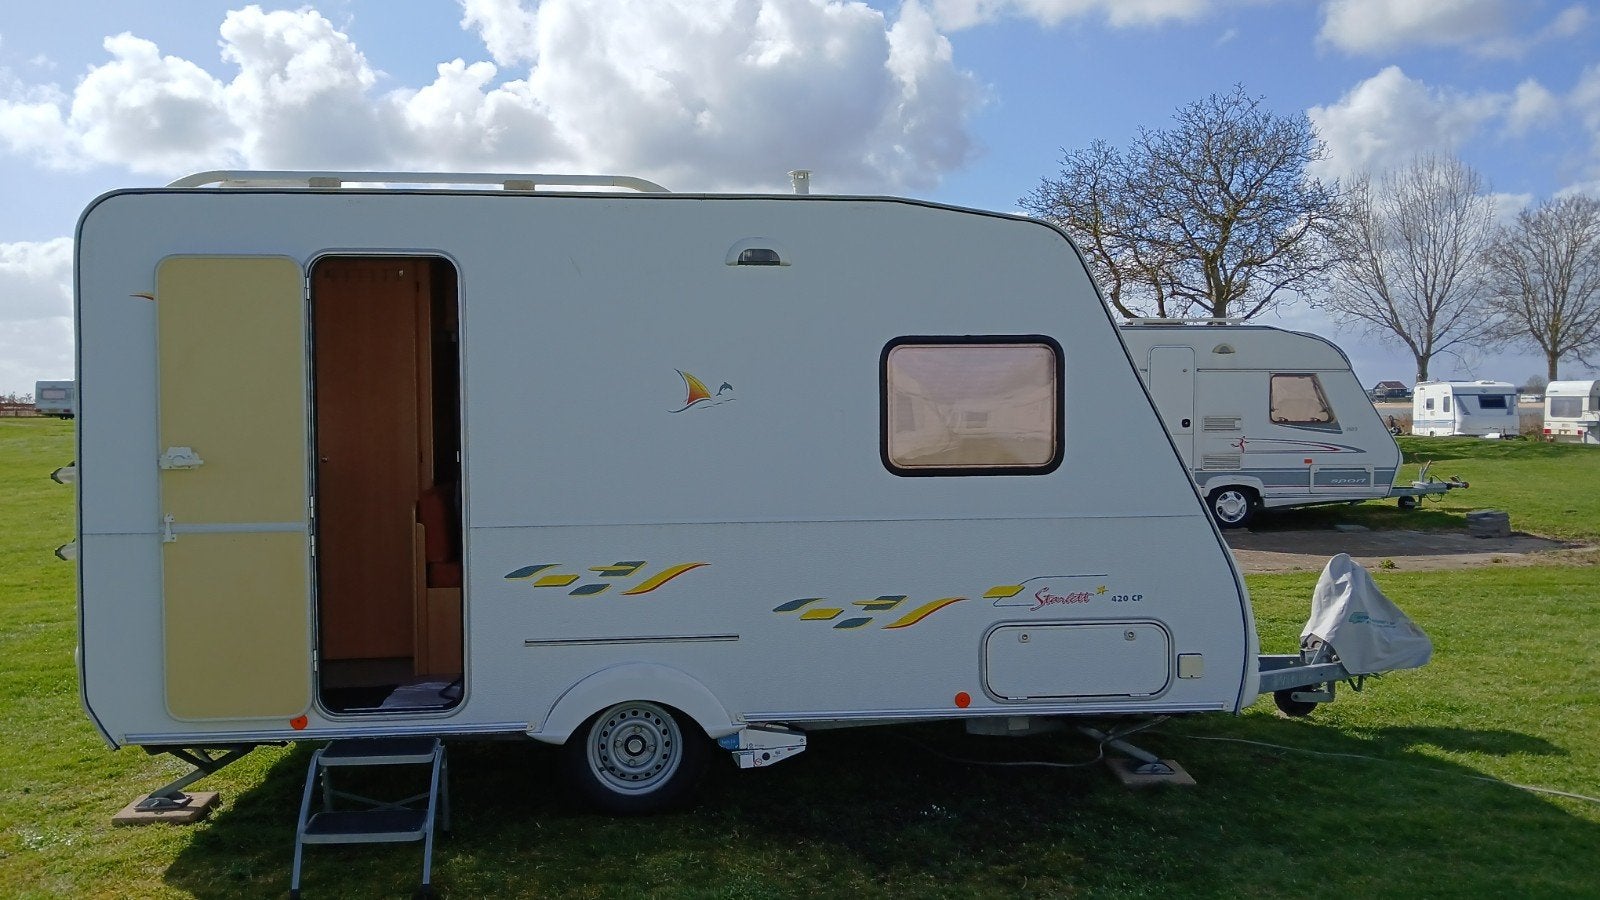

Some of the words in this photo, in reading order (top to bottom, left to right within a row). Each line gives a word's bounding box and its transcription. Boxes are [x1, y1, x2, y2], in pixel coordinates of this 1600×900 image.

[1030, 586, 1095, 612] Starlett
[1111, 594, 1129, 603] 420
[1131, 594, 1143, 602] CP
